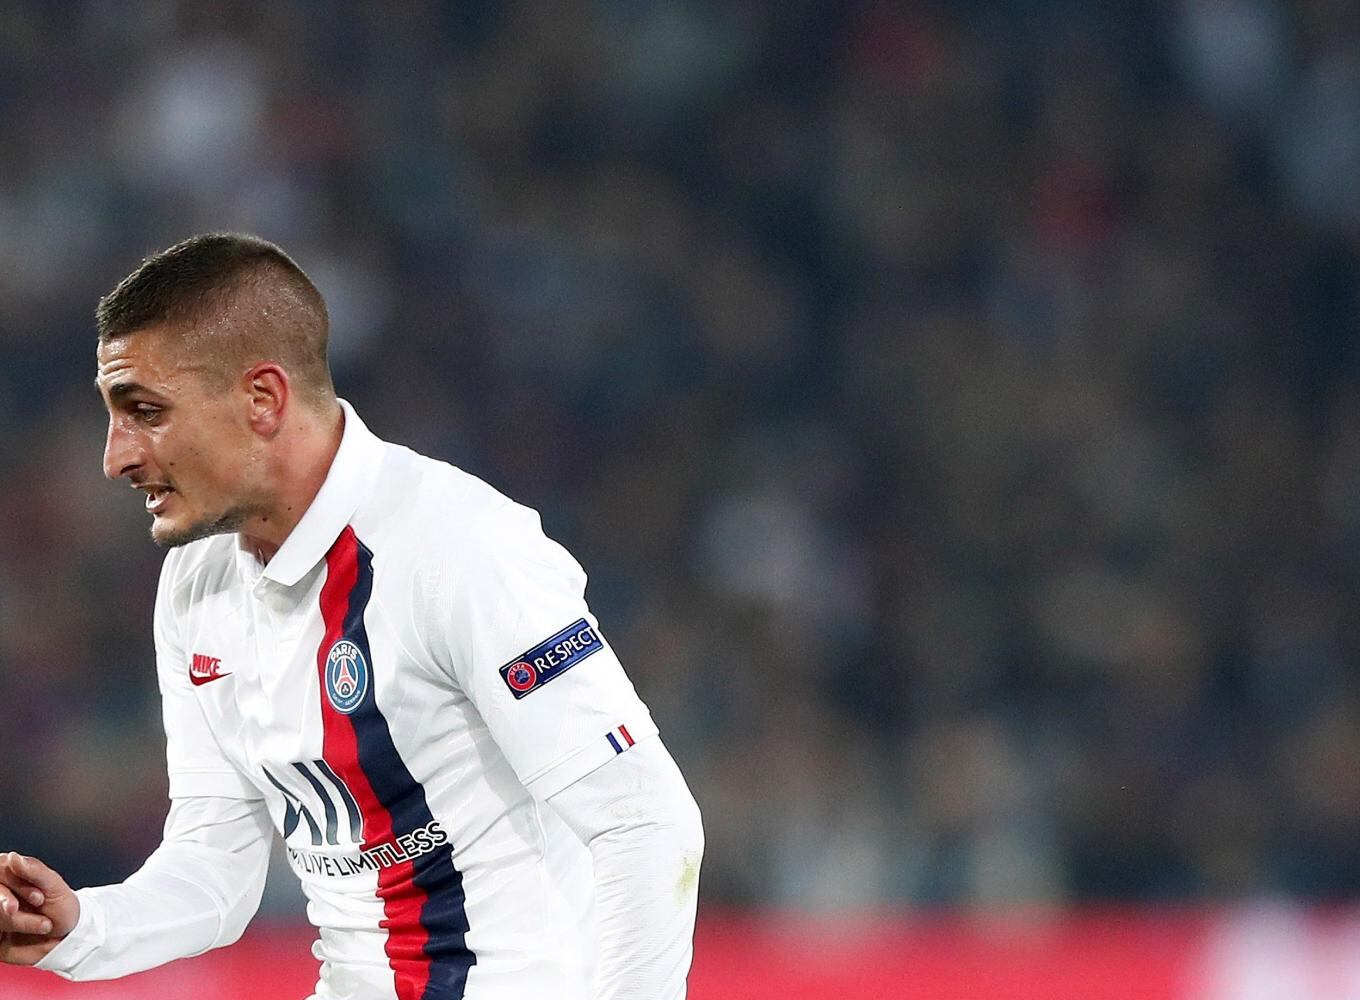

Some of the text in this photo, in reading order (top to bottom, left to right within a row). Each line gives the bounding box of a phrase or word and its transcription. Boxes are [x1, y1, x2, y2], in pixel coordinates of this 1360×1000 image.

[330, 643, 358, 663] PARIS
[533, 626, 597, 674] RESPECT
[192, 652, 222, 677] NIKE
[509, 663, 525, 677] UEFA
[301, 852, 335, 876] LIVE
[334, 821, 448, 877] LIMITLESS
